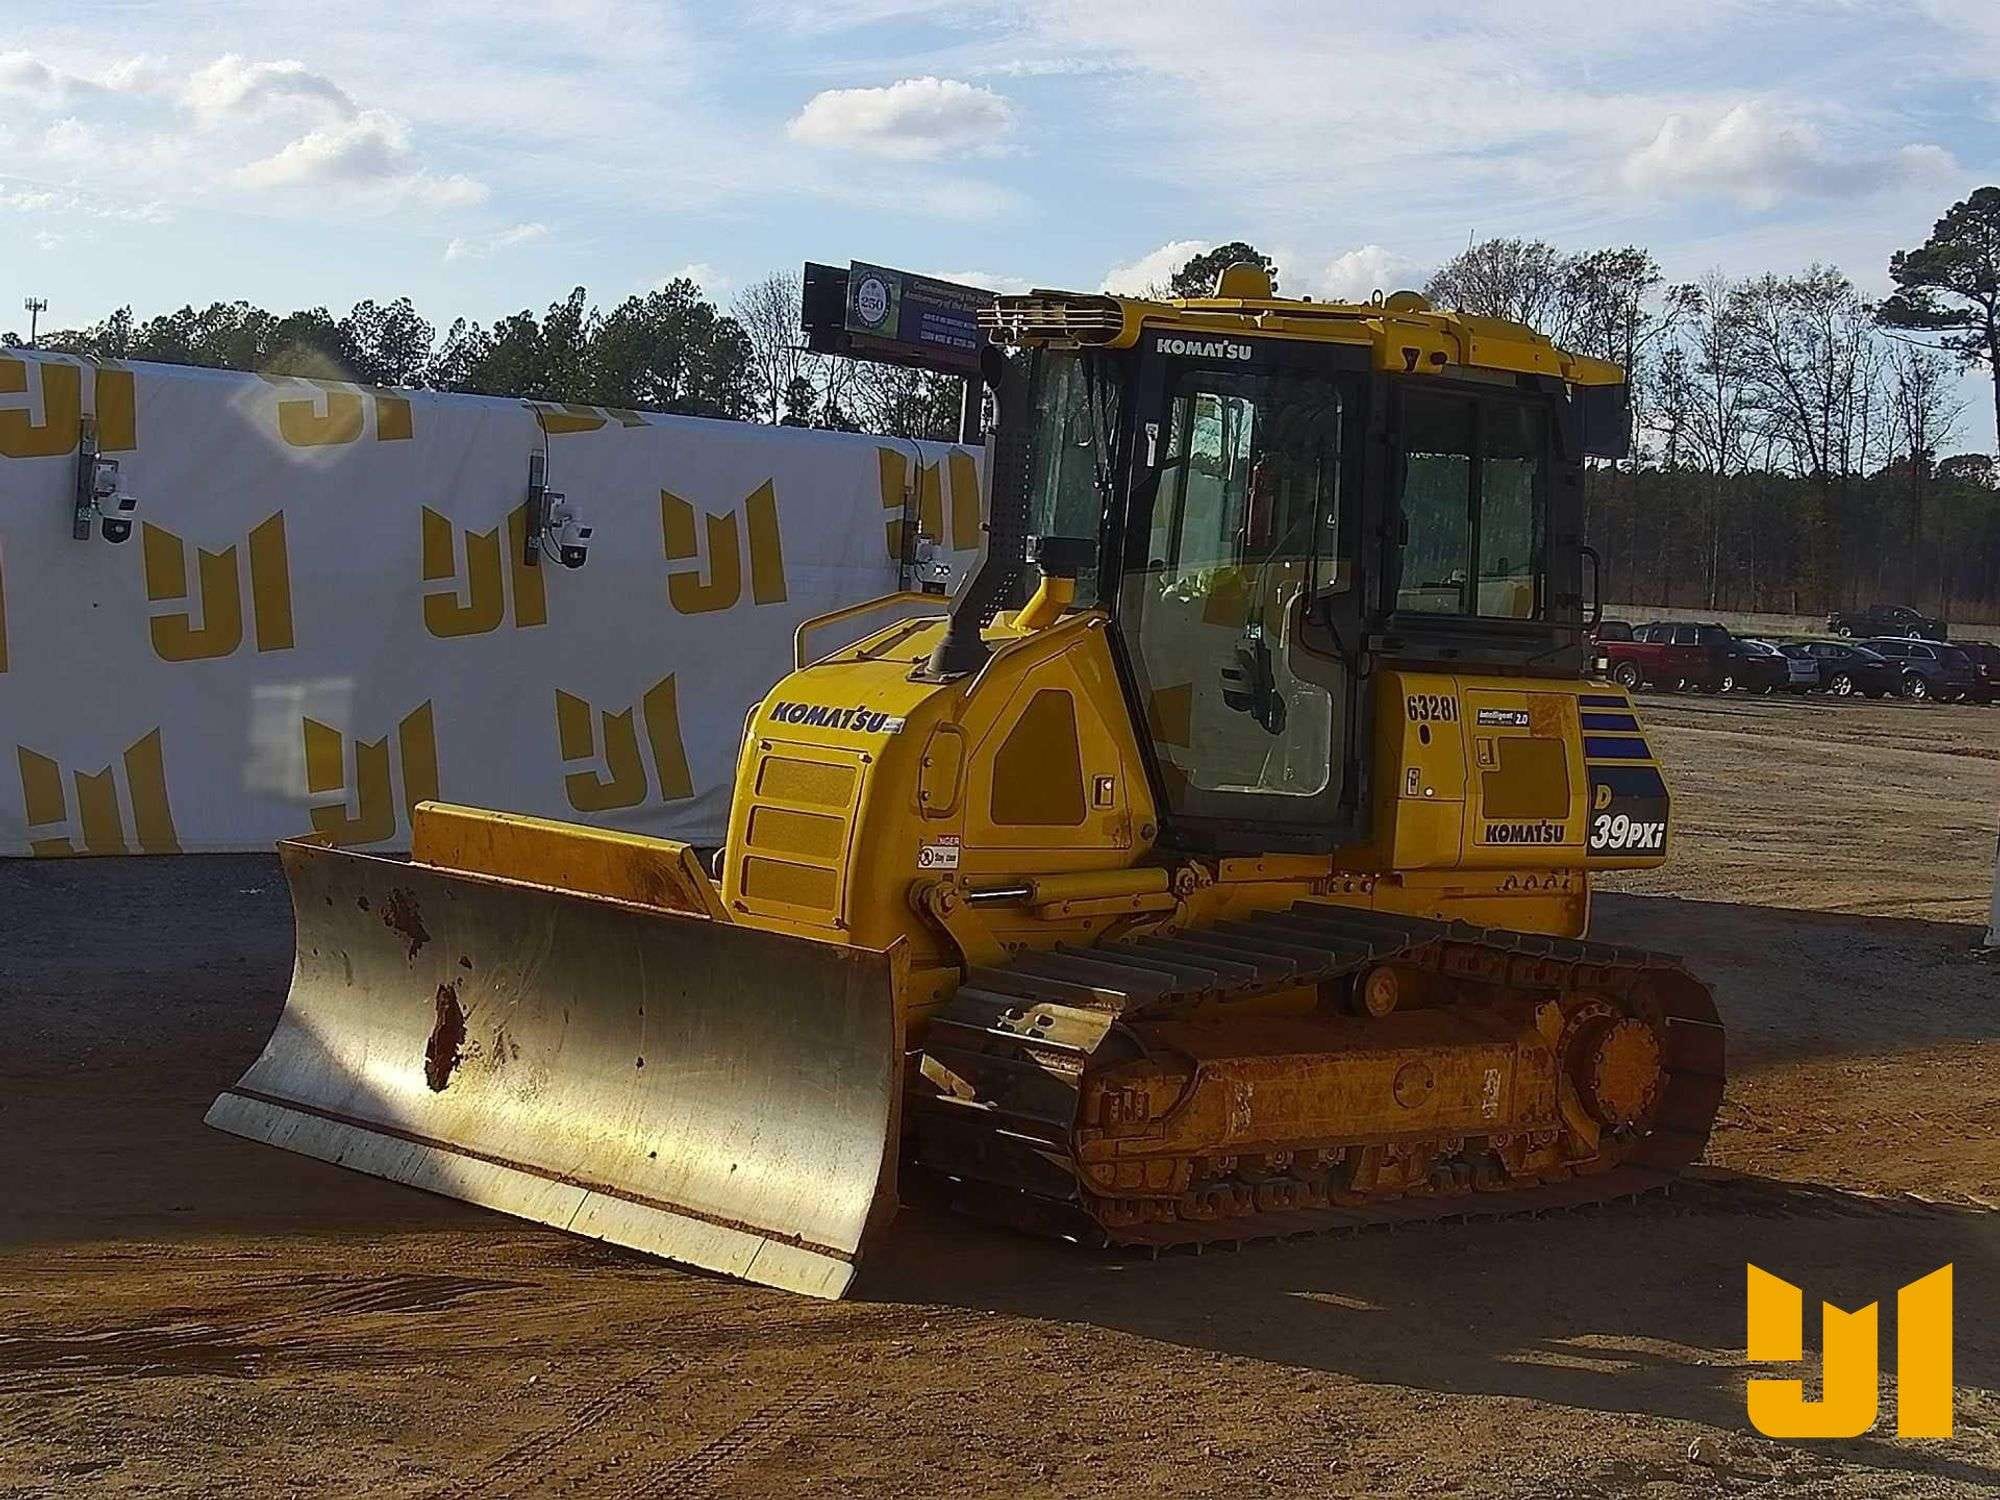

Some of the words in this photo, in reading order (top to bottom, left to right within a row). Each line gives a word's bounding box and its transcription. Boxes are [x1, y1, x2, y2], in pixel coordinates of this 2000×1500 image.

[861, 296, 884, 311] 250
[1157, 338, 1252, 360] KOMATSU
[769, 702, 889, 732] KOMATSU
[1515, 714, 1529, 725] 2.0
[1594, 784, 1612, 810] D
[1486, 818, 1565, 843] KOMATSU
[1591, 814, 1665, 849] 39PXi
